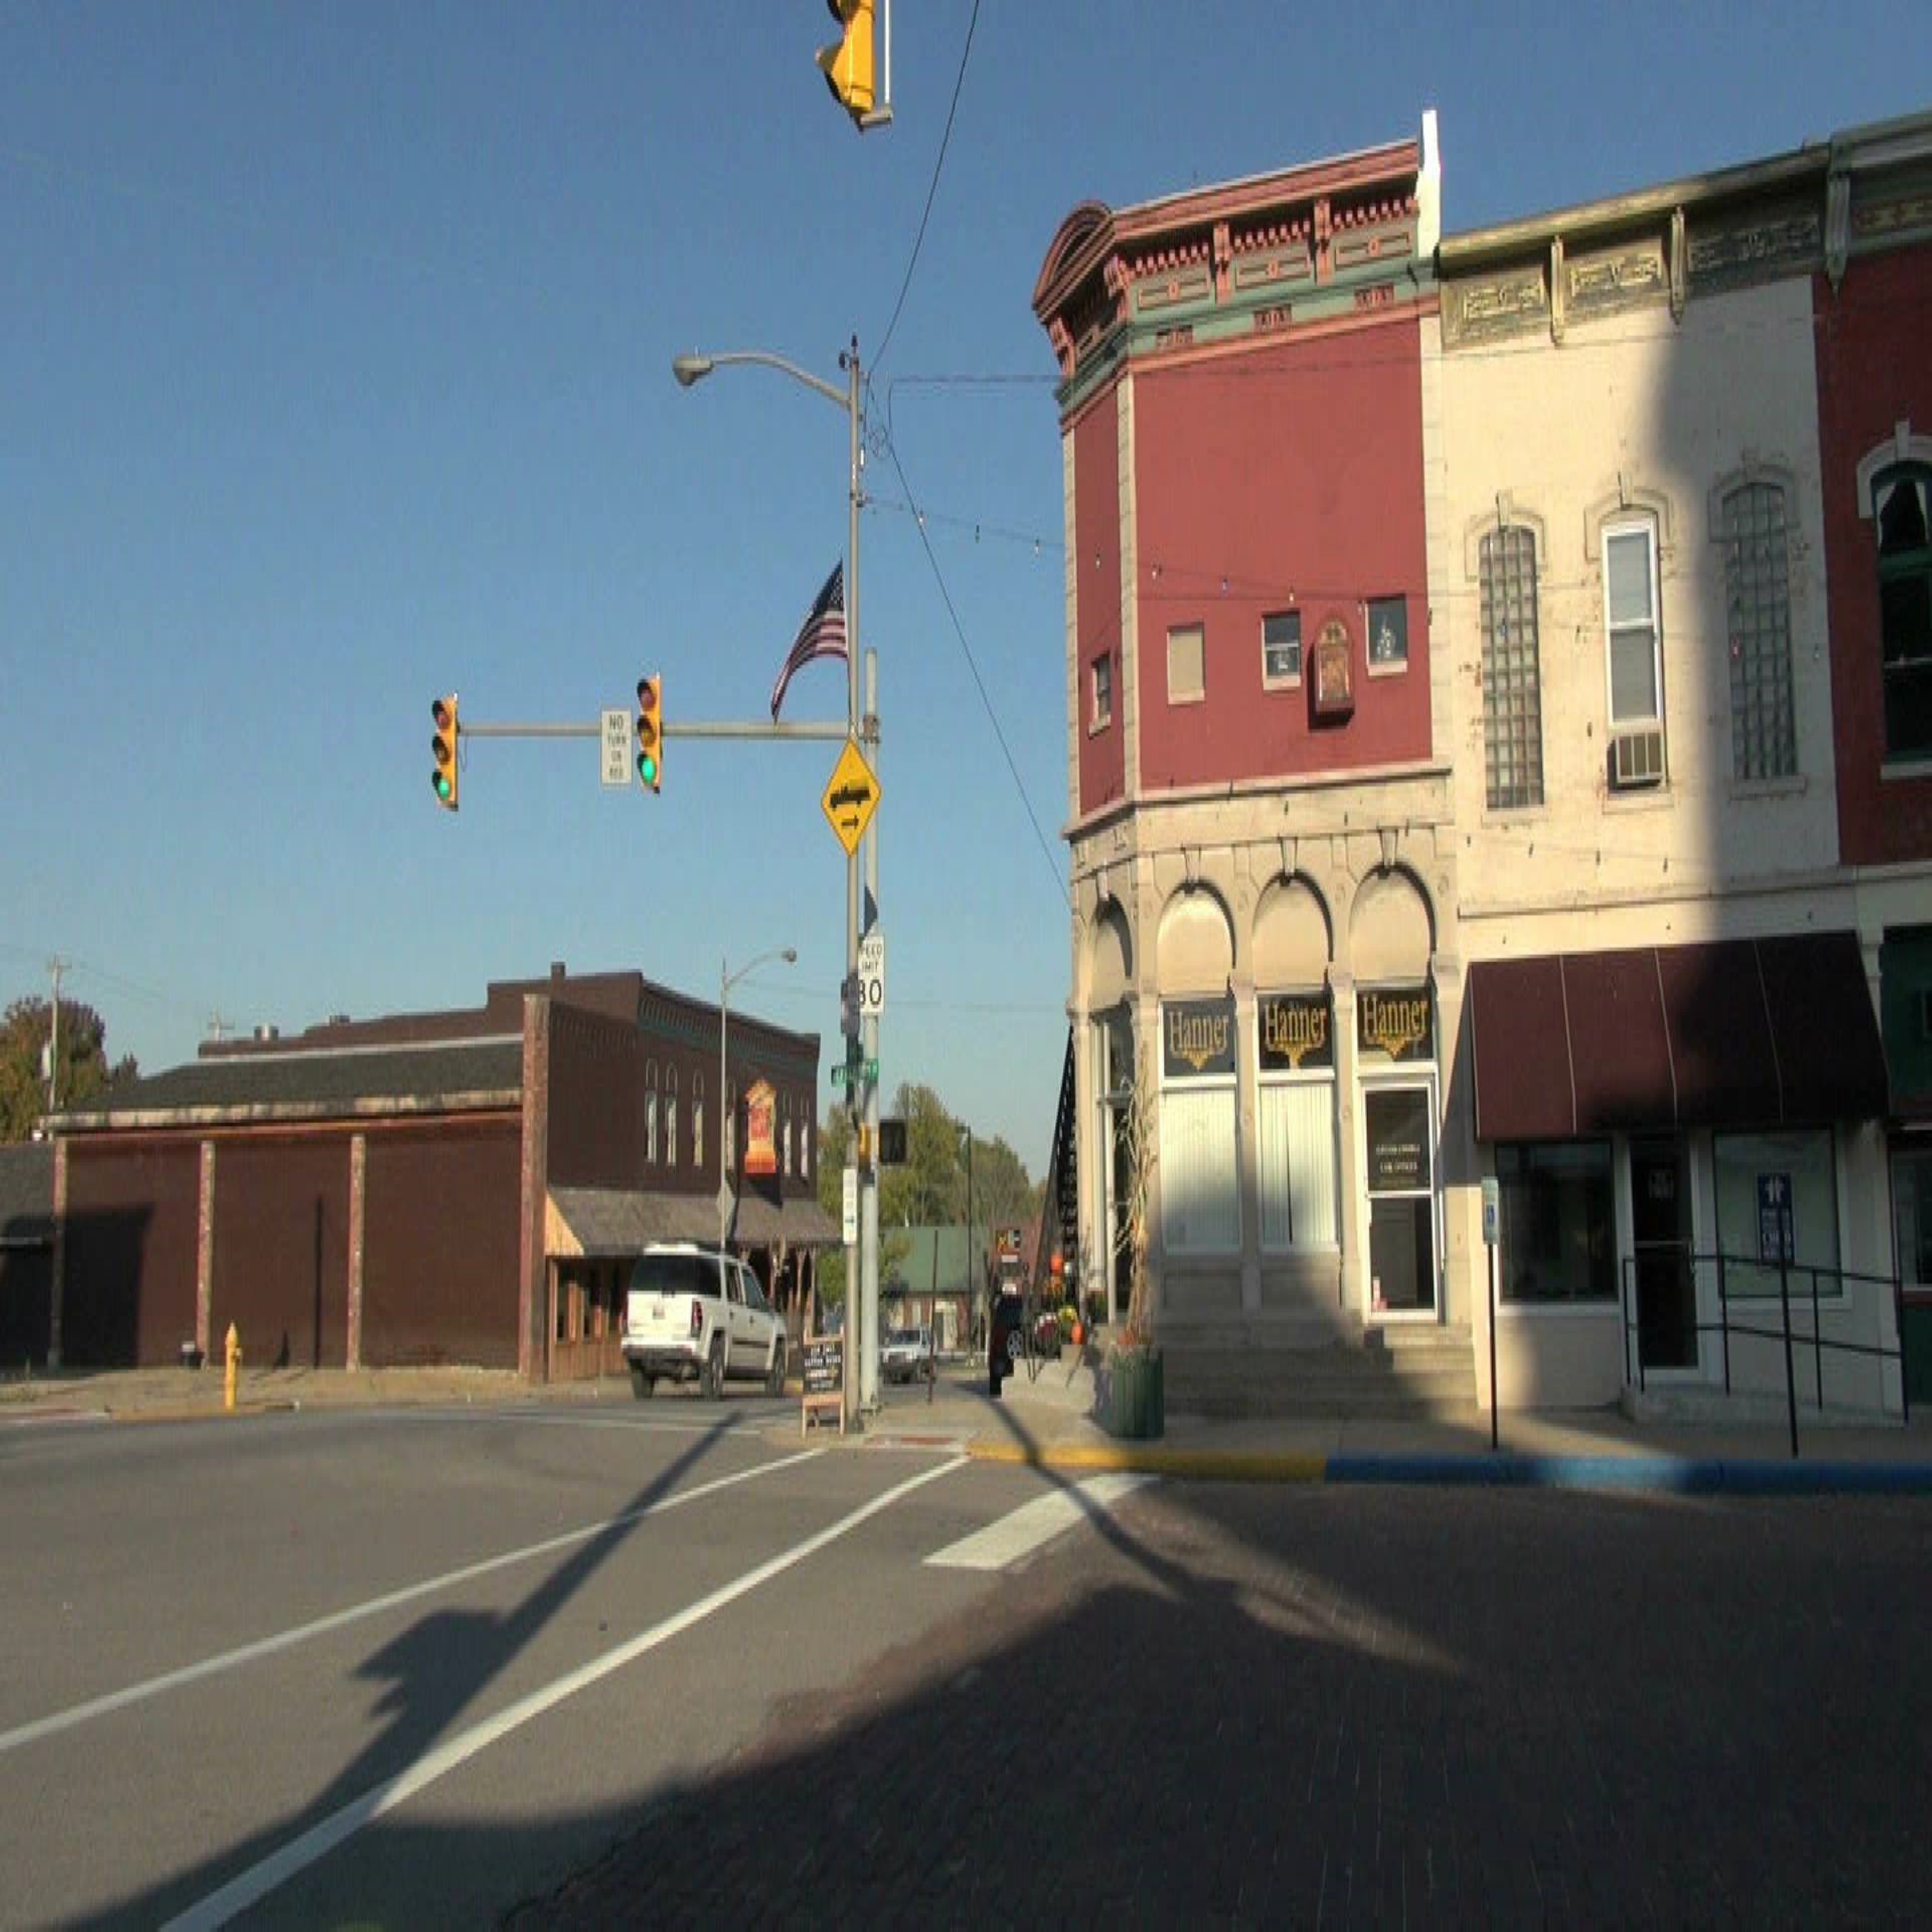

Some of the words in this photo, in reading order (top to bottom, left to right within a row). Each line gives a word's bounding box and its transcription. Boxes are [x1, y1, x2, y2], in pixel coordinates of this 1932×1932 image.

[609, 714, 624, 730] NO
[858, 979, 882, 1005] 30
[1167, 1010, 1229, 1049] Hanner
[1264, 1003, 1327, 1043] Hanner
[1363, 996, 1428, 1035] Hanner
